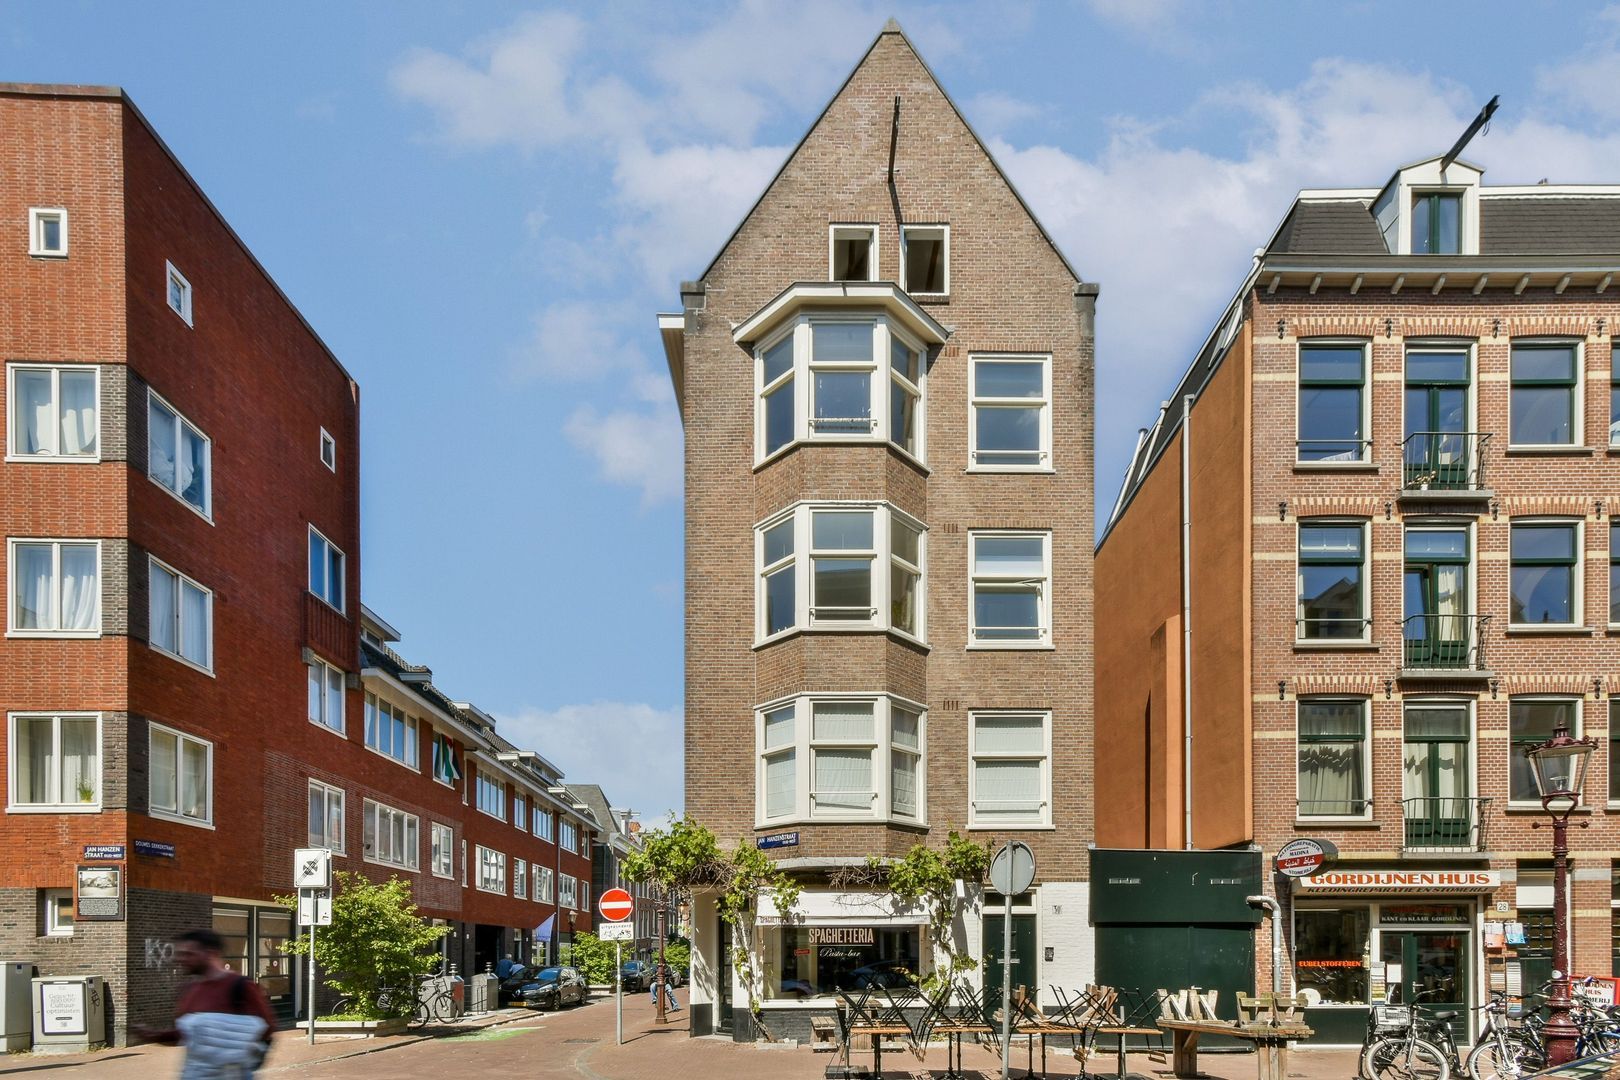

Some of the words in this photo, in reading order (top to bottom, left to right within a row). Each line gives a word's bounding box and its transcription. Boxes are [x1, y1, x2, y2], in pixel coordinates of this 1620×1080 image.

[1288, 867, 1312, 875] STOMERIJ
[1310, 873, 1434, 885] GORDIJNEN
[1438, 873, 1490, 885] HUIS
[1498, 903, 1507, 911] 28
[809, 928, 874, 943] SPAGHETTERIA
[820, 948, 861, 957] Pasta-bar
